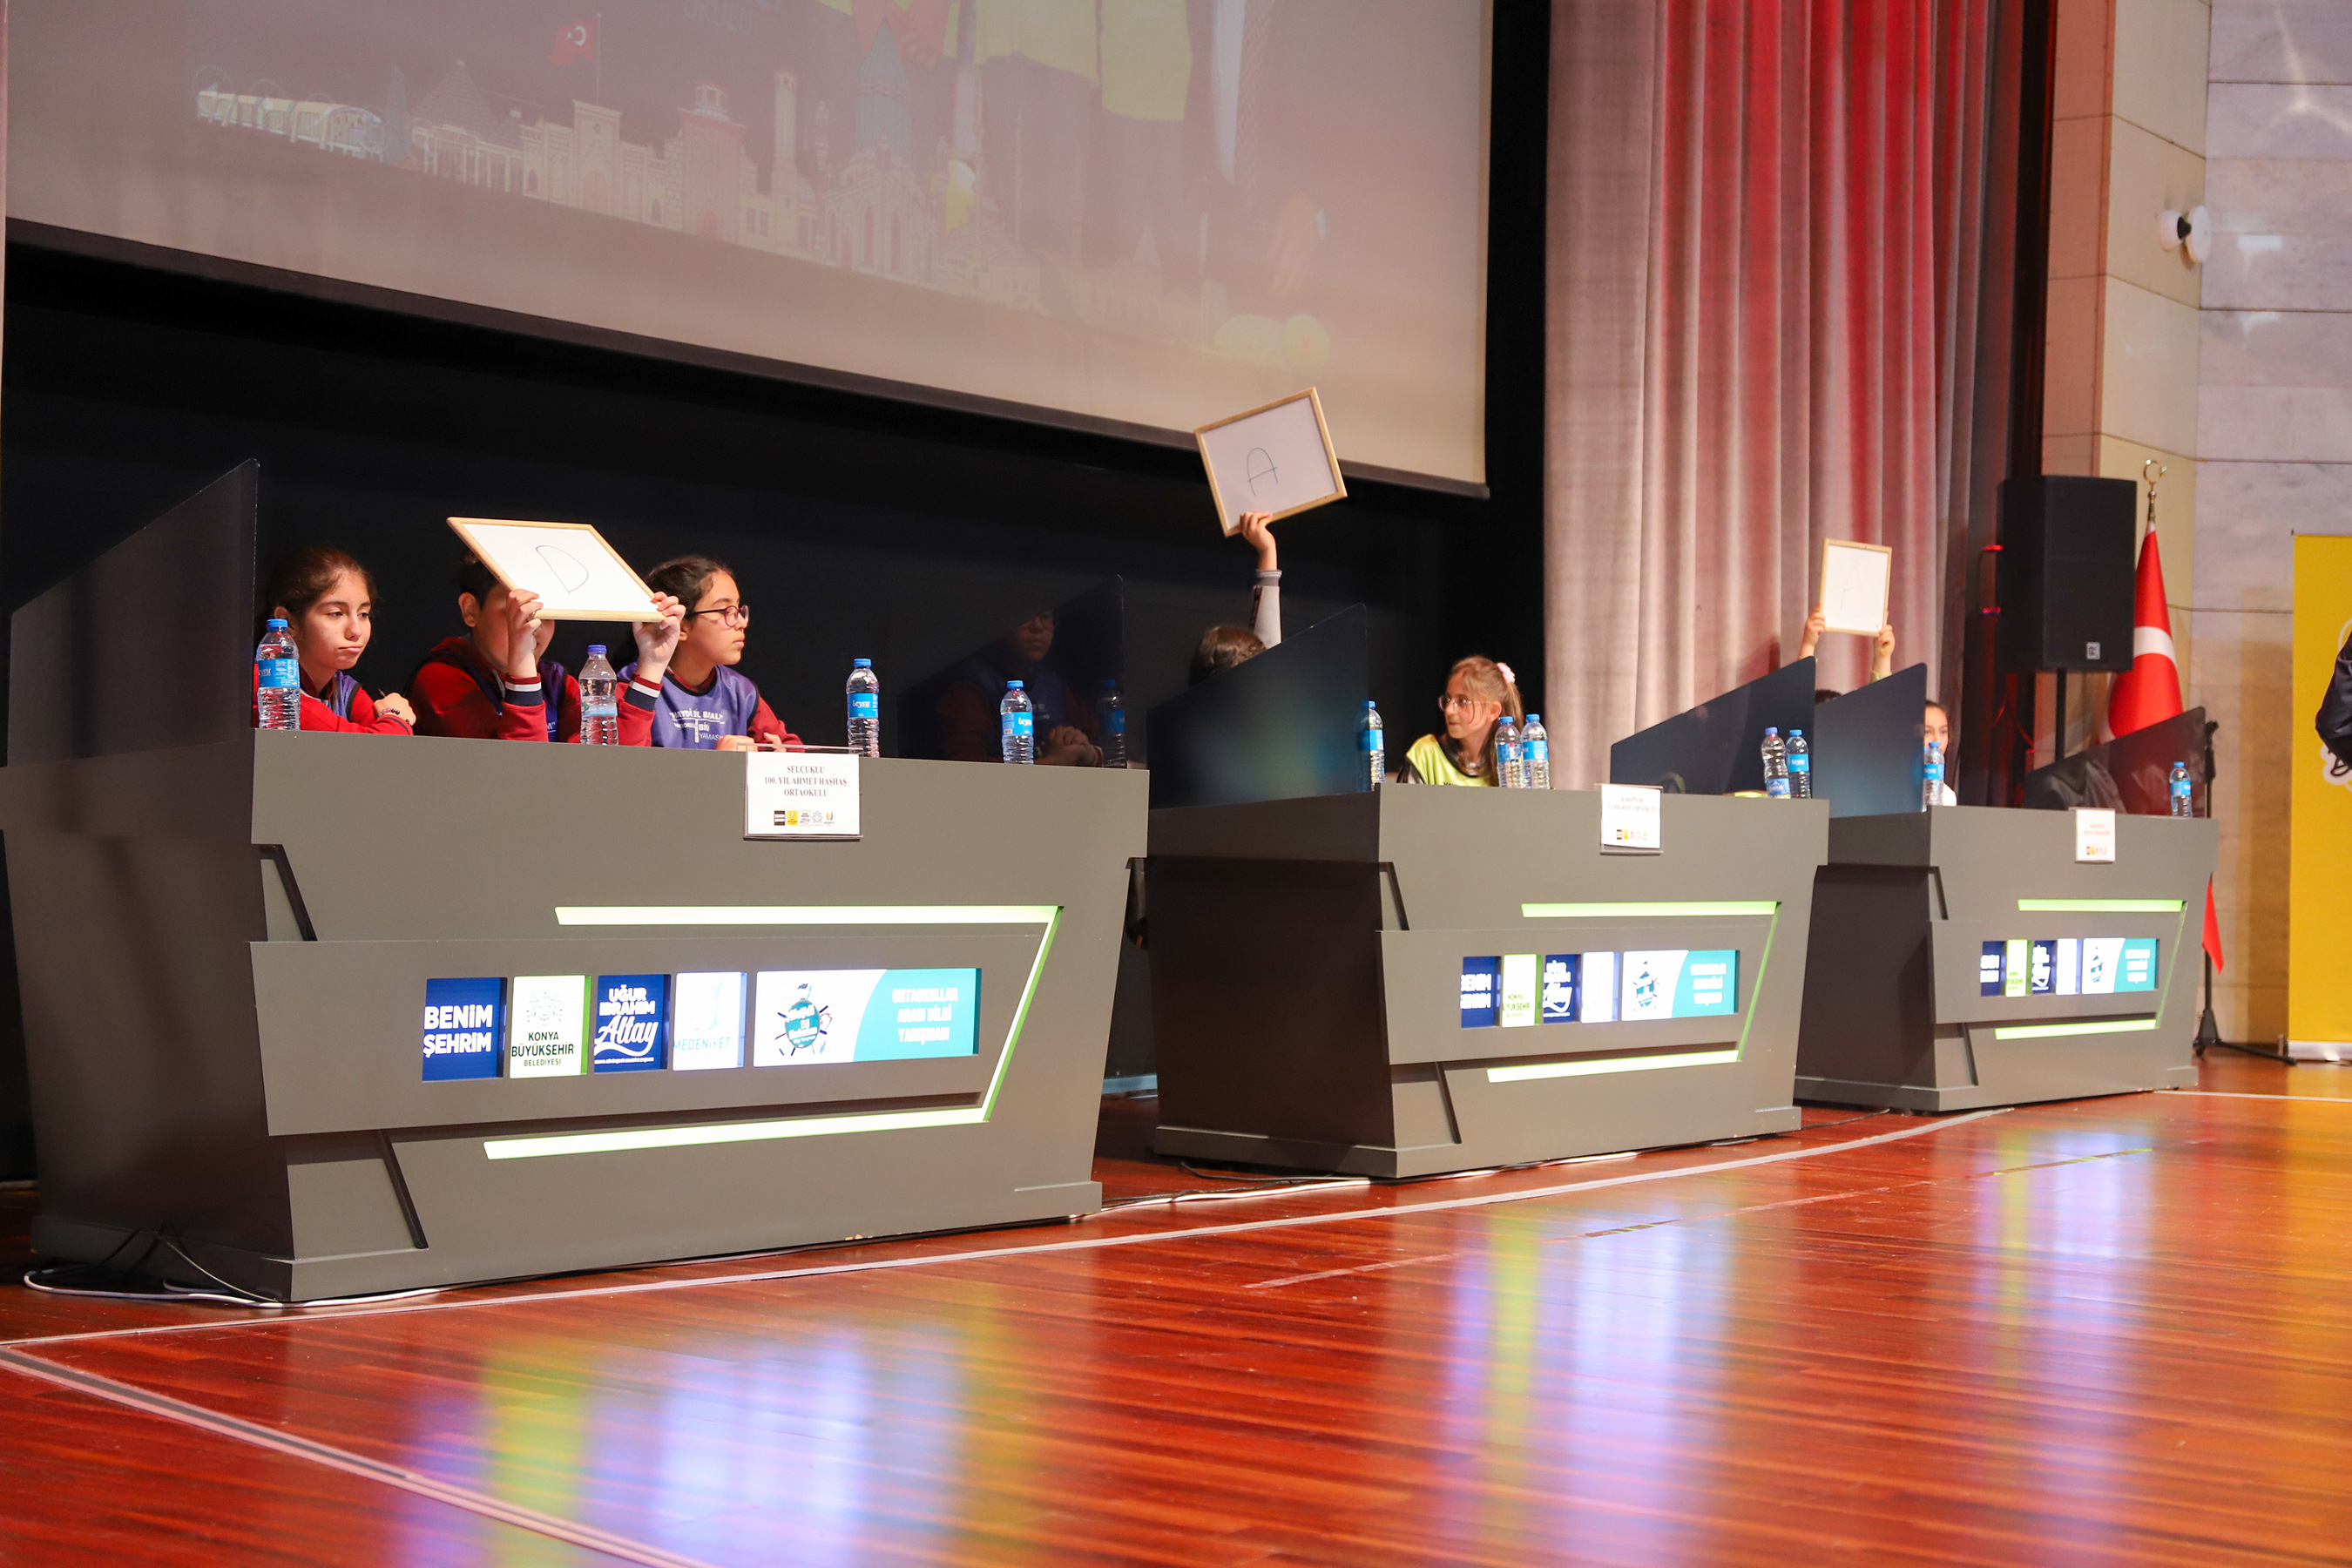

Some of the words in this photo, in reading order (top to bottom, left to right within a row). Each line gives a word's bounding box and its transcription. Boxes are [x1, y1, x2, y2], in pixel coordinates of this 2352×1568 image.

[1247, 447, 1279, 497] A
[536, 544, 590, 595] D
[787, 766, 825, 774] SELÇUKLU
[791, 777, 818, 786] AHMET
[819, 778, 848, 787] HAŞHAŞ
[784, 788, 828, 797] ORTAOKULU
[423, 1004, 493, 1030] BENİM
[422, 1031, 492, 1058] ŞEHRİM
[528, 1031, 559, 1042] KONYA
